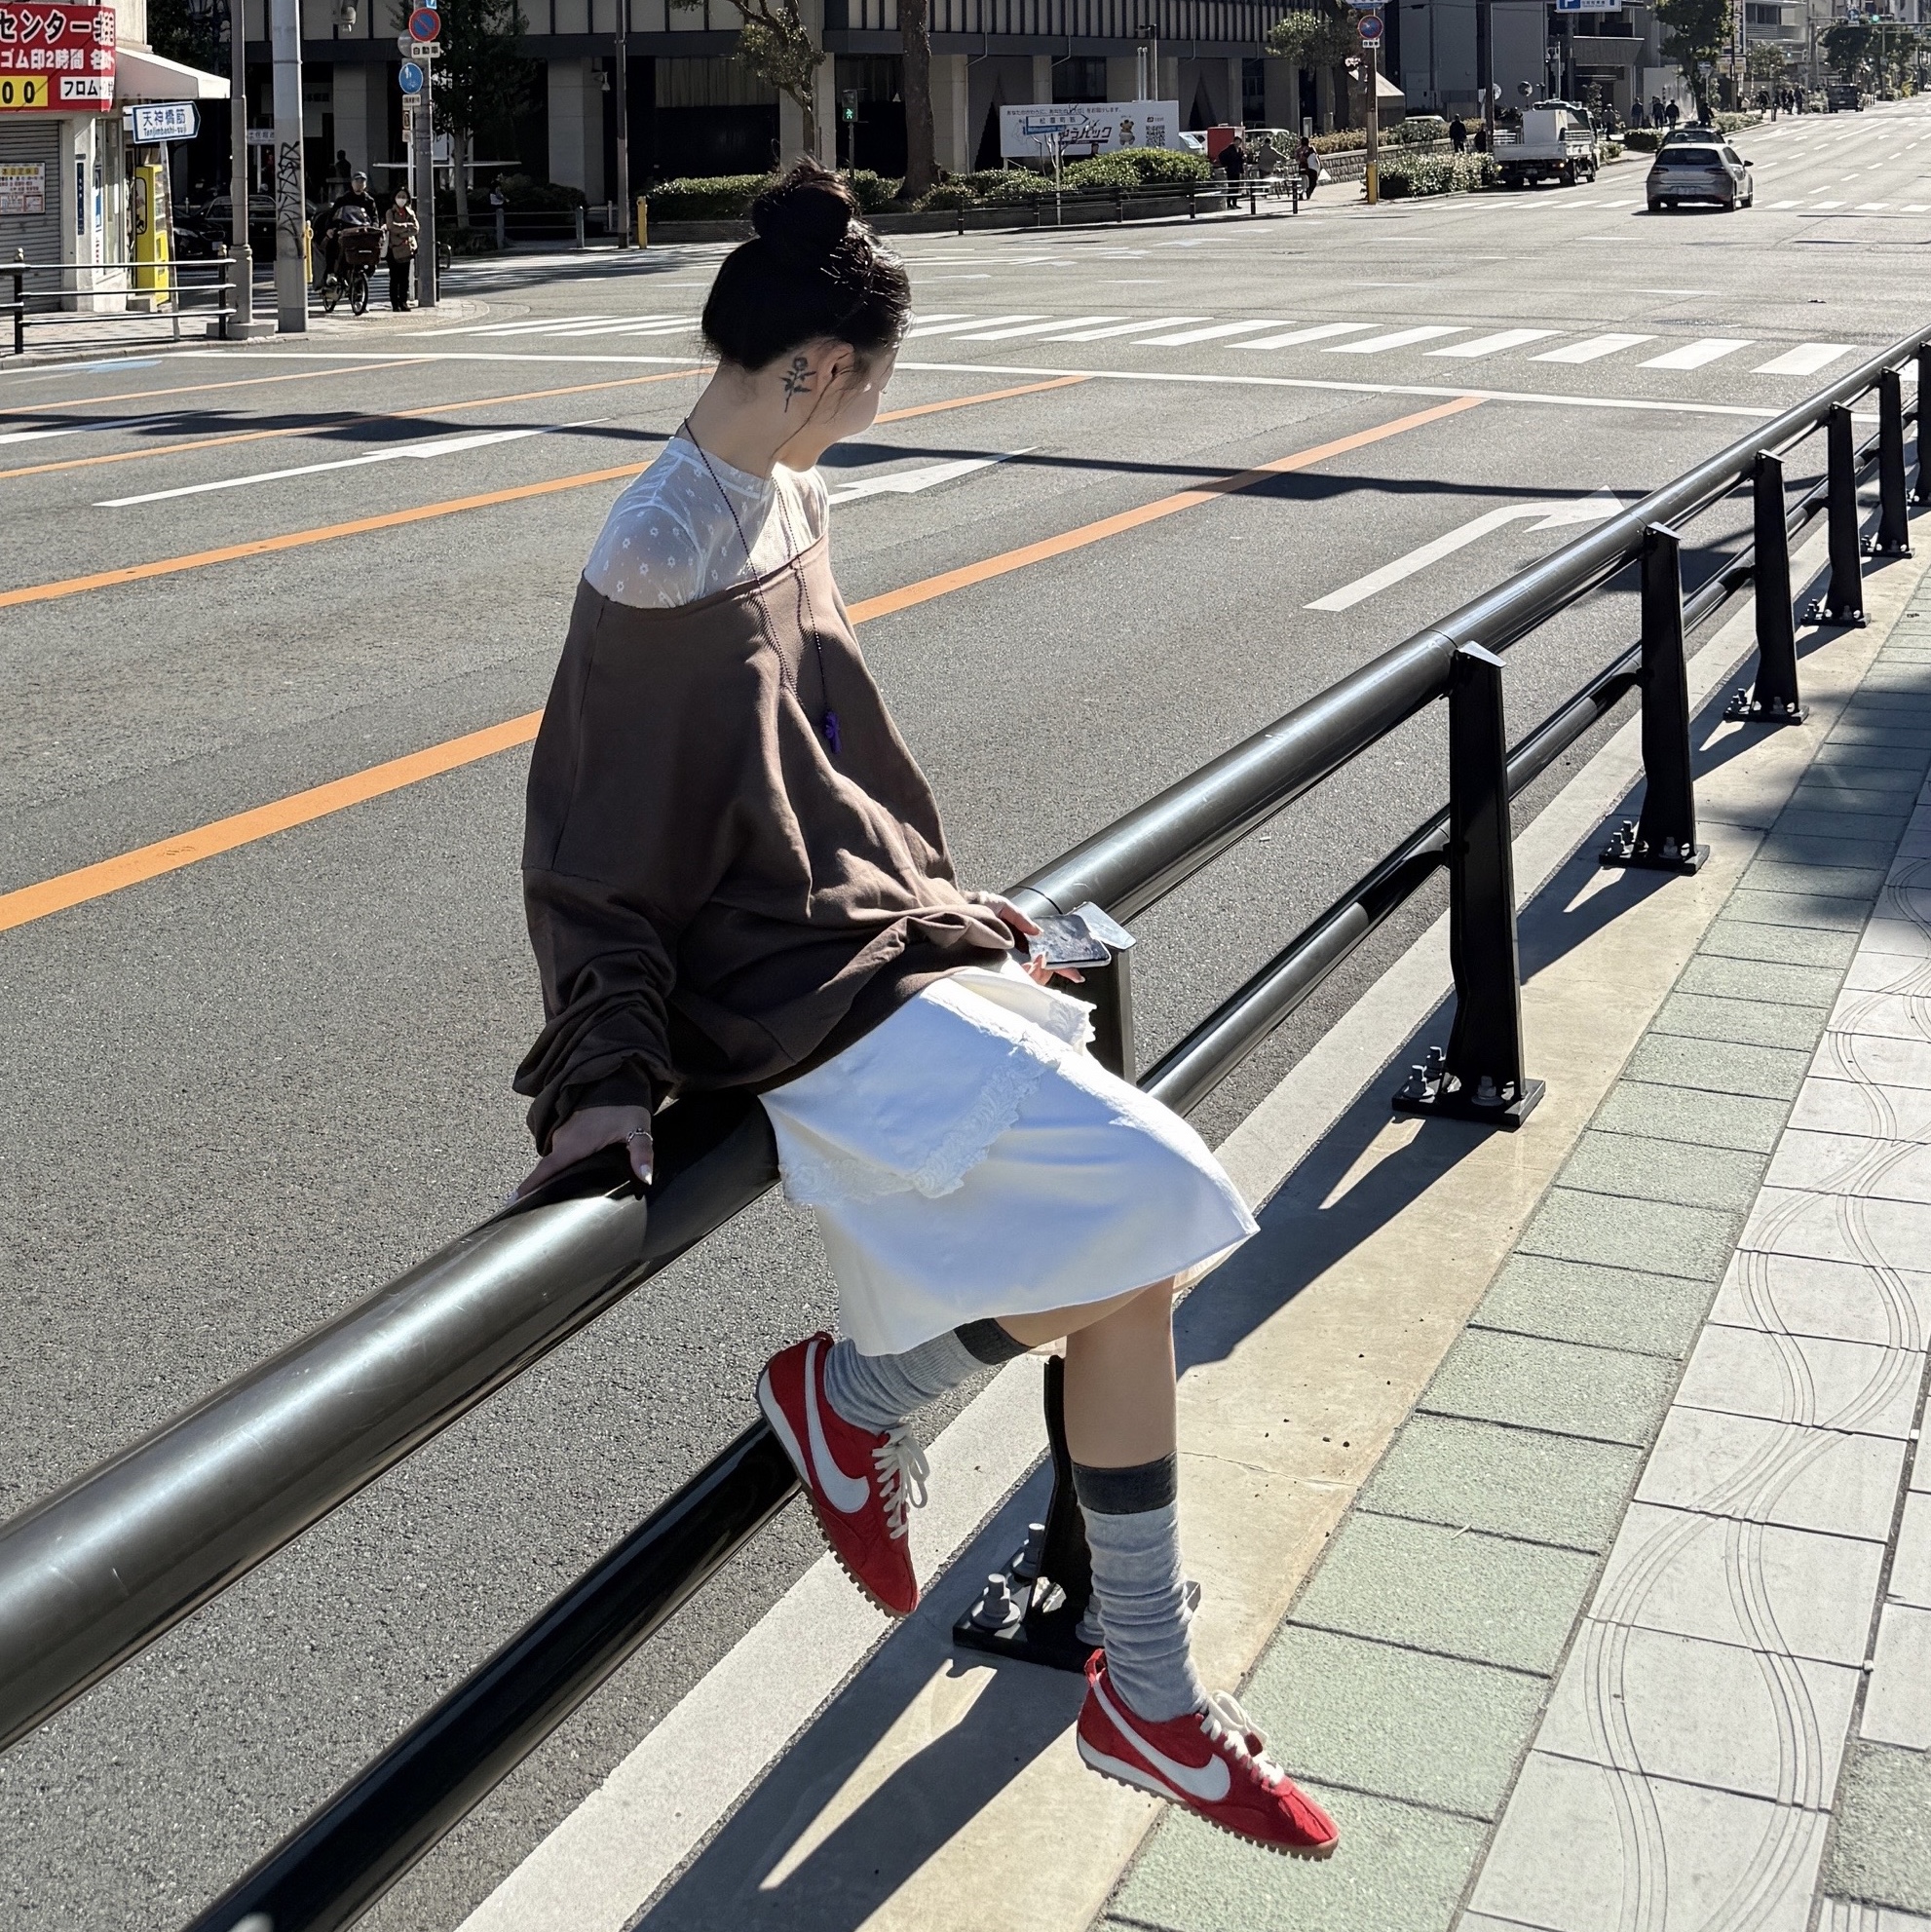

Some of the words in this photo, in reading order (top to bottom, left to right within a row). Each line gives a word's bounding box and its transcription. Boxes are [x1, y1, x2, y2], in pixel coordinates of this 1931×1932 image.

[0, 48, 85, 70] ゴム印2時間
[142, 108, 185, 127] 天神橋筋
